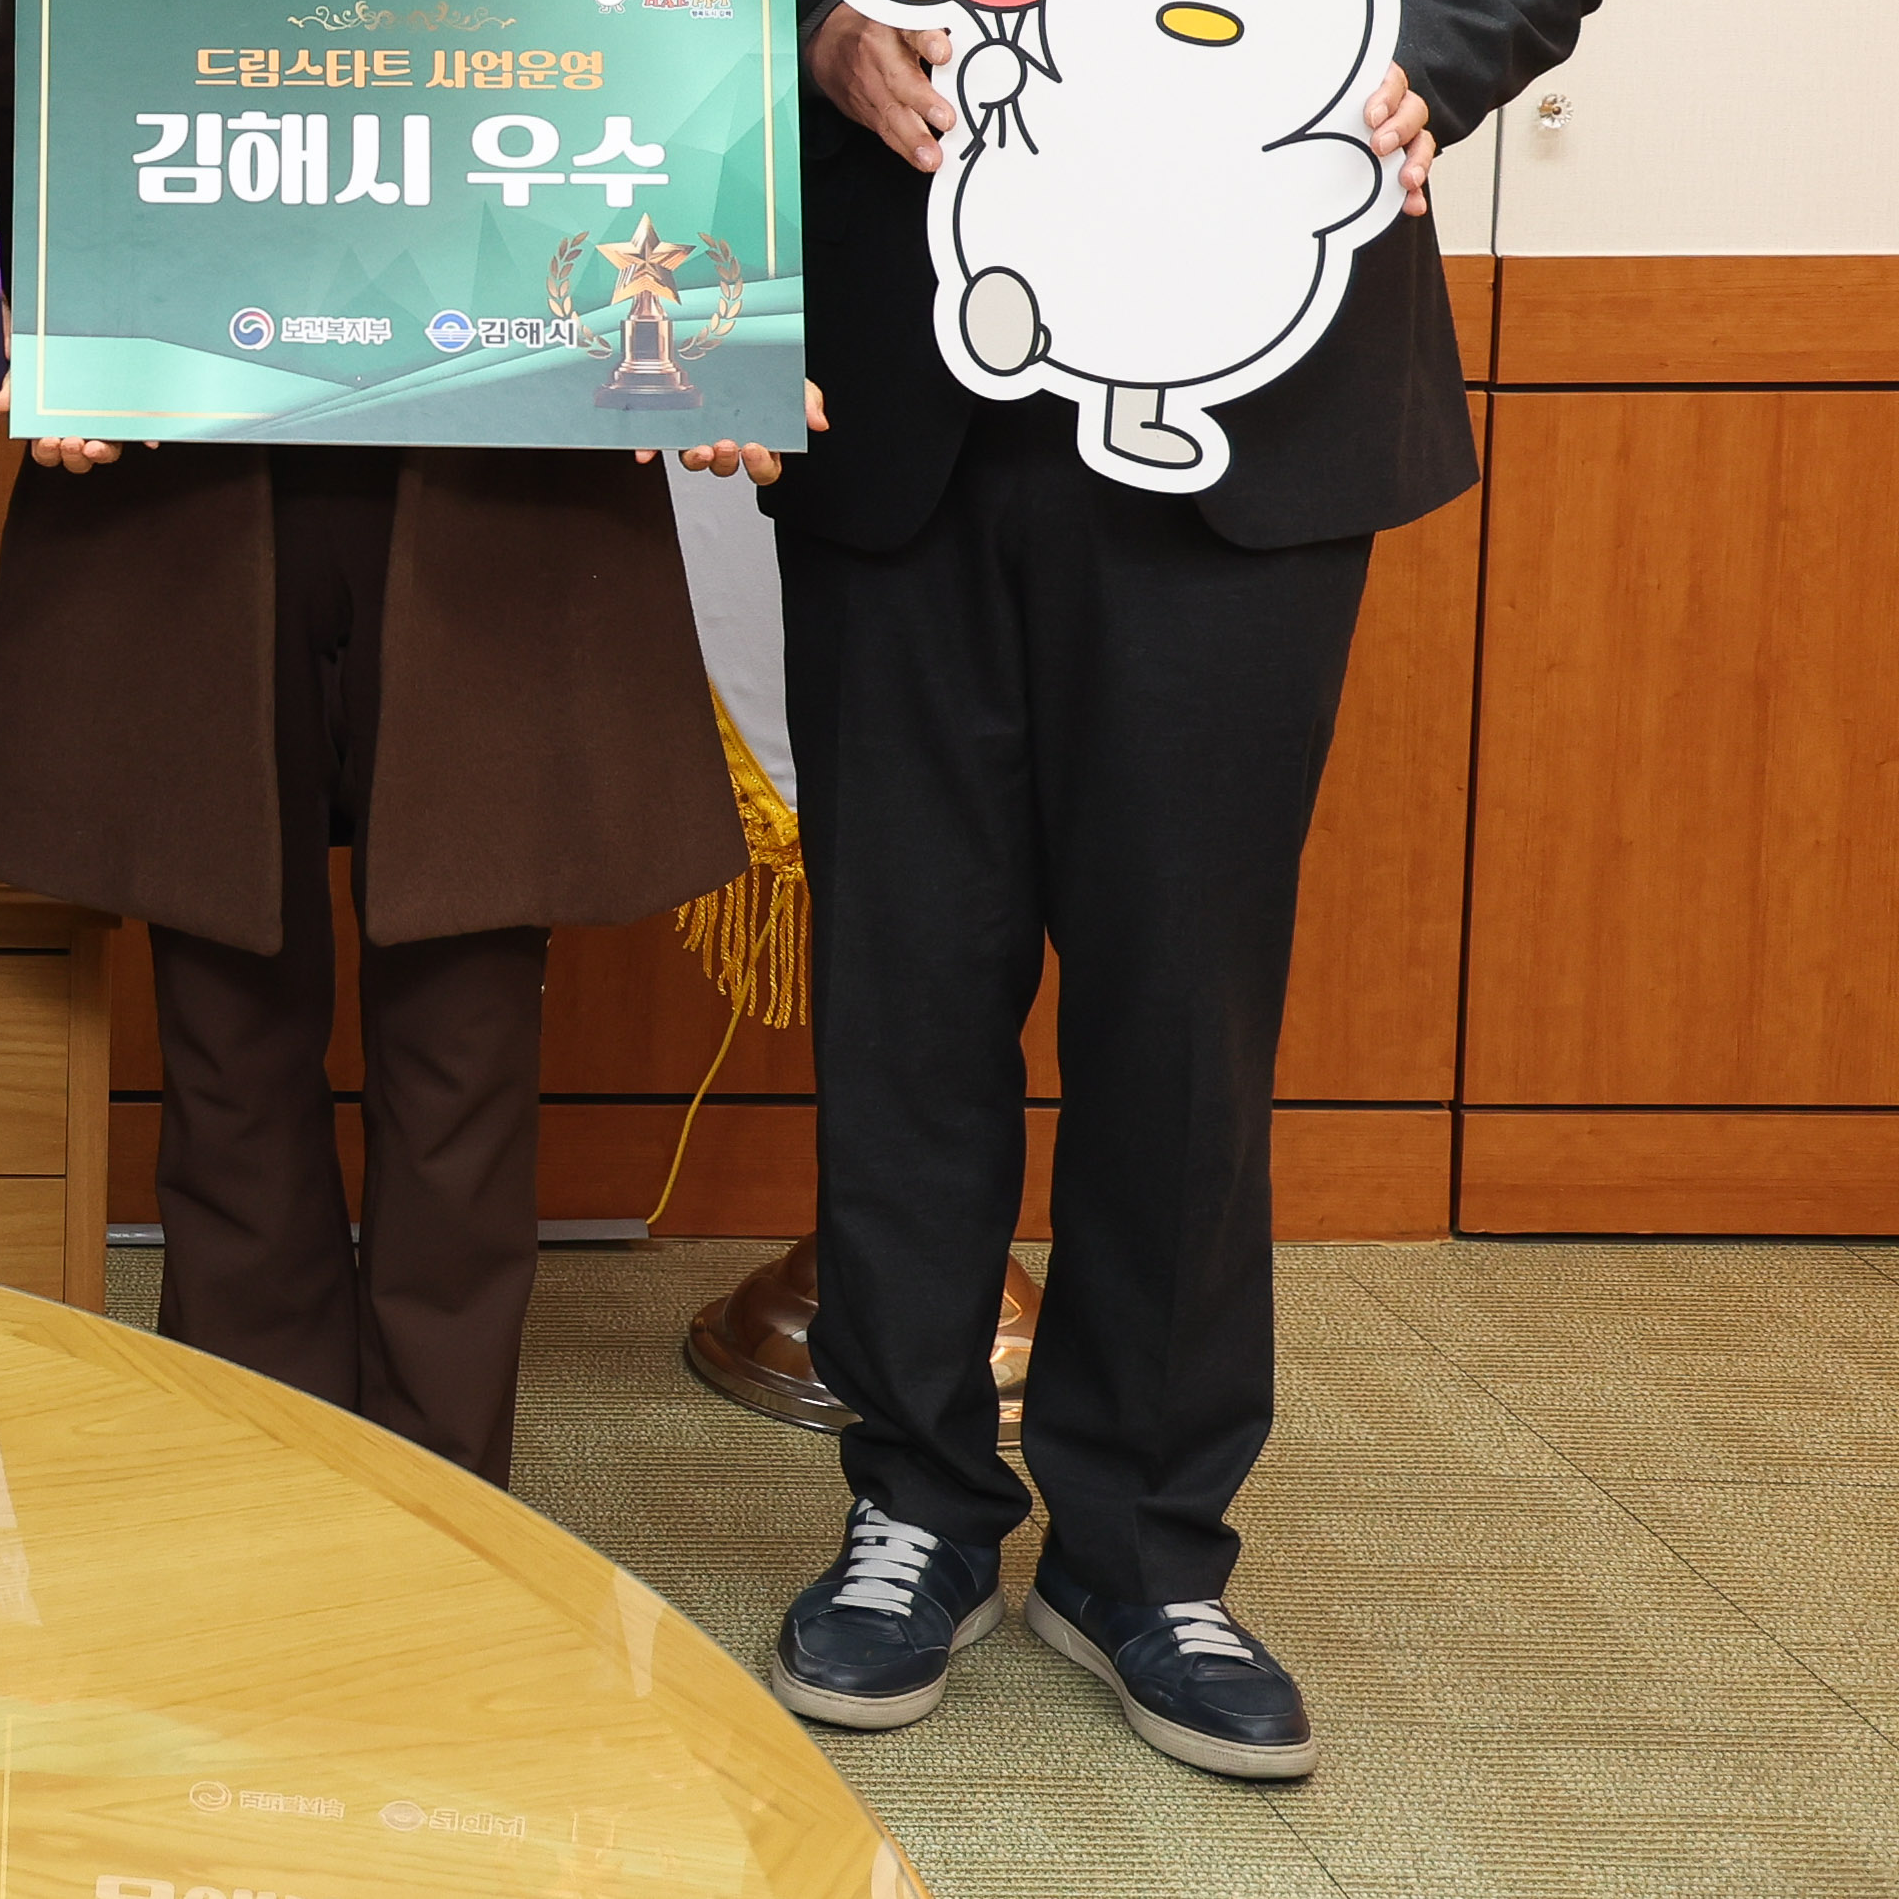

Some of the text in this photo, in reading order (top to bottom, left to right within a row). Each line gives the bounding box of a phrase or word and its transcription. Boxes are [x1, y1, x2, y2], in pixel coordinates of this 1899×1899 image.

[194, 47, 605, 91] 드림스타트 사업운영
[131, 109, 671, 210] 김해시 우수
[280, 316, 393, 346] 보건복지부
[477, 318, 579, 349] 김해시
